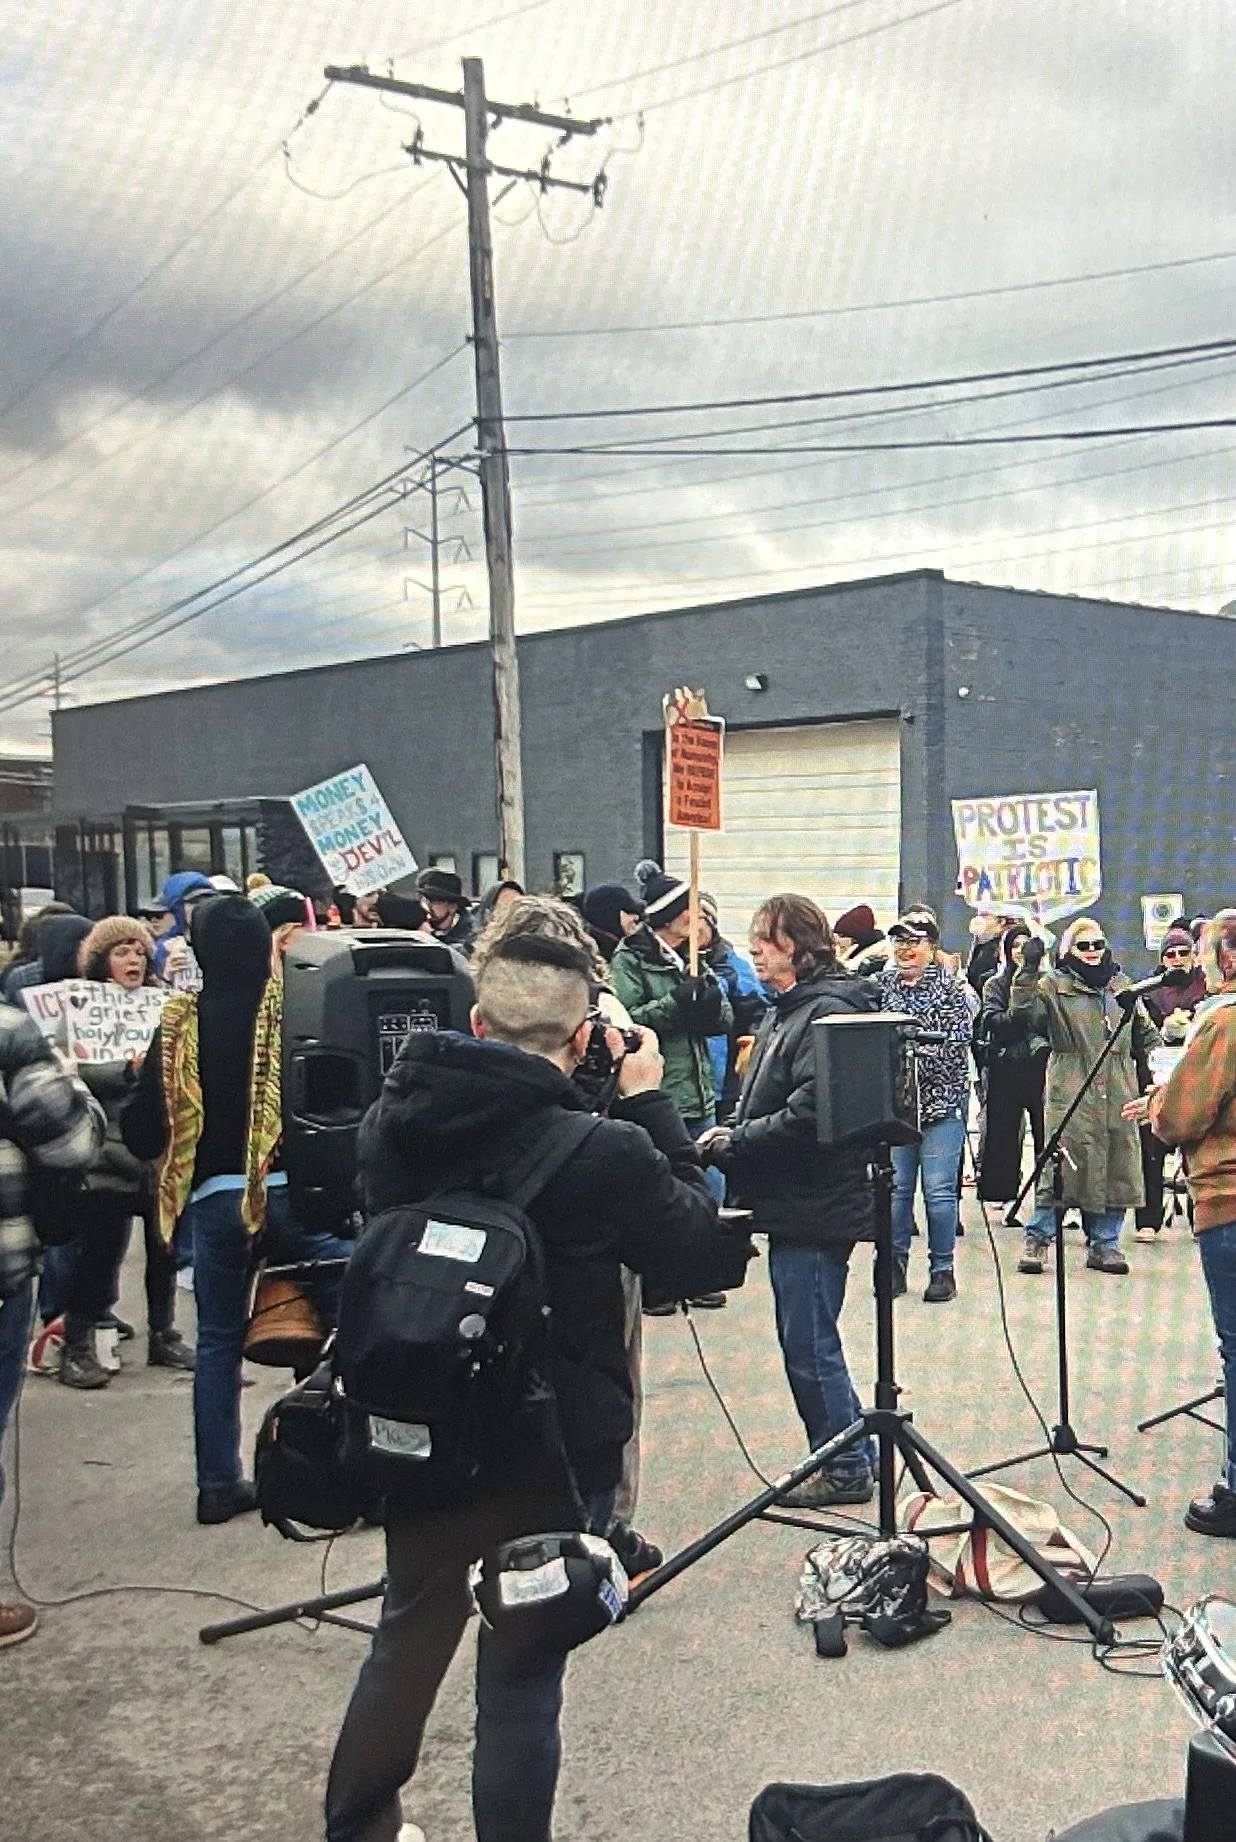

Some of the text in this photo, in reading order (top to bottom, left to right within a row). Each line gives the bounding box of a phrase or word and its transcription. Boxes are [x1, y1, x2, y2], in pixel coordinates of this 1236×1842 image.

[296, 771, 367, 817] MONEY
[316, 811, 383, 856] MONEY
[957, 794, 1092, 840] PROTEST
[1001, 835, 1049, 861] IS
[962, 857, 1098, 901] PATRIOTIC
[83, 983, 134, 1007] this
[88, 1003, 149, 1026] grief
